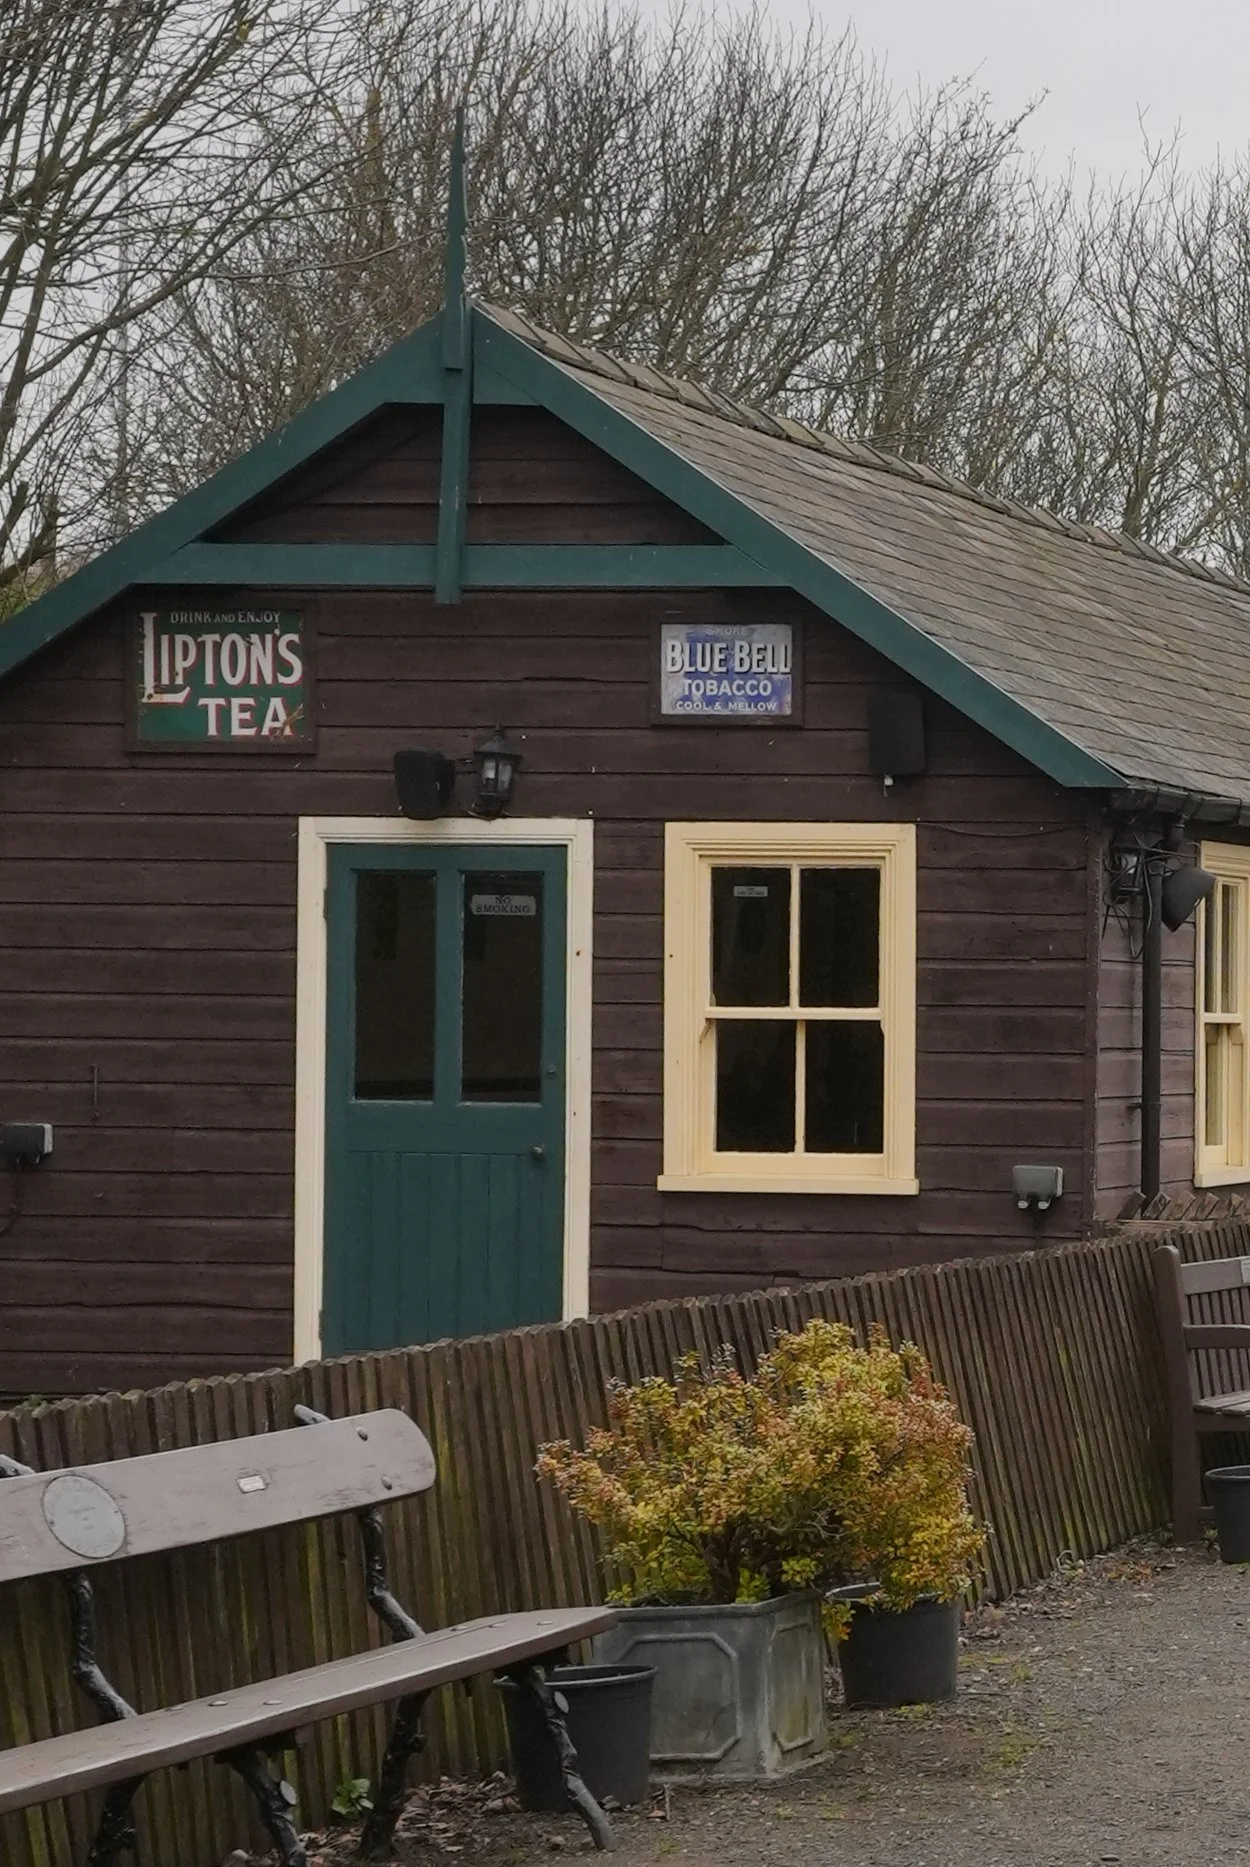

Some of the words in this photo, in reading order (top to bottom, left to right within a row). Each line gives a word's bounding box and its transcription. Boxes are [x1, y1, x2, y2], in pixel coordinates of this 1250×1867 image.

[170, 612, 211, 623] DRINK
[214, 613, 236, 623] AND
[238, 611, 281, 623] ENJOY
[139, 612, 304, 704] LIPTON'S
[667, 640, 728, 674] BLUE
[735, 640, 791, 674] BELL
[683, 680, 772, 696] TOBACCO
[676, 701, 711, 711] COOL
[713, 700, 722, 711] &
[727, 700, 777, 711] MELLOW
[197, 697, 293, 737] TEA
[495, 896, 511, 904] NO
[475, 904, 530, 913] SMOKING
